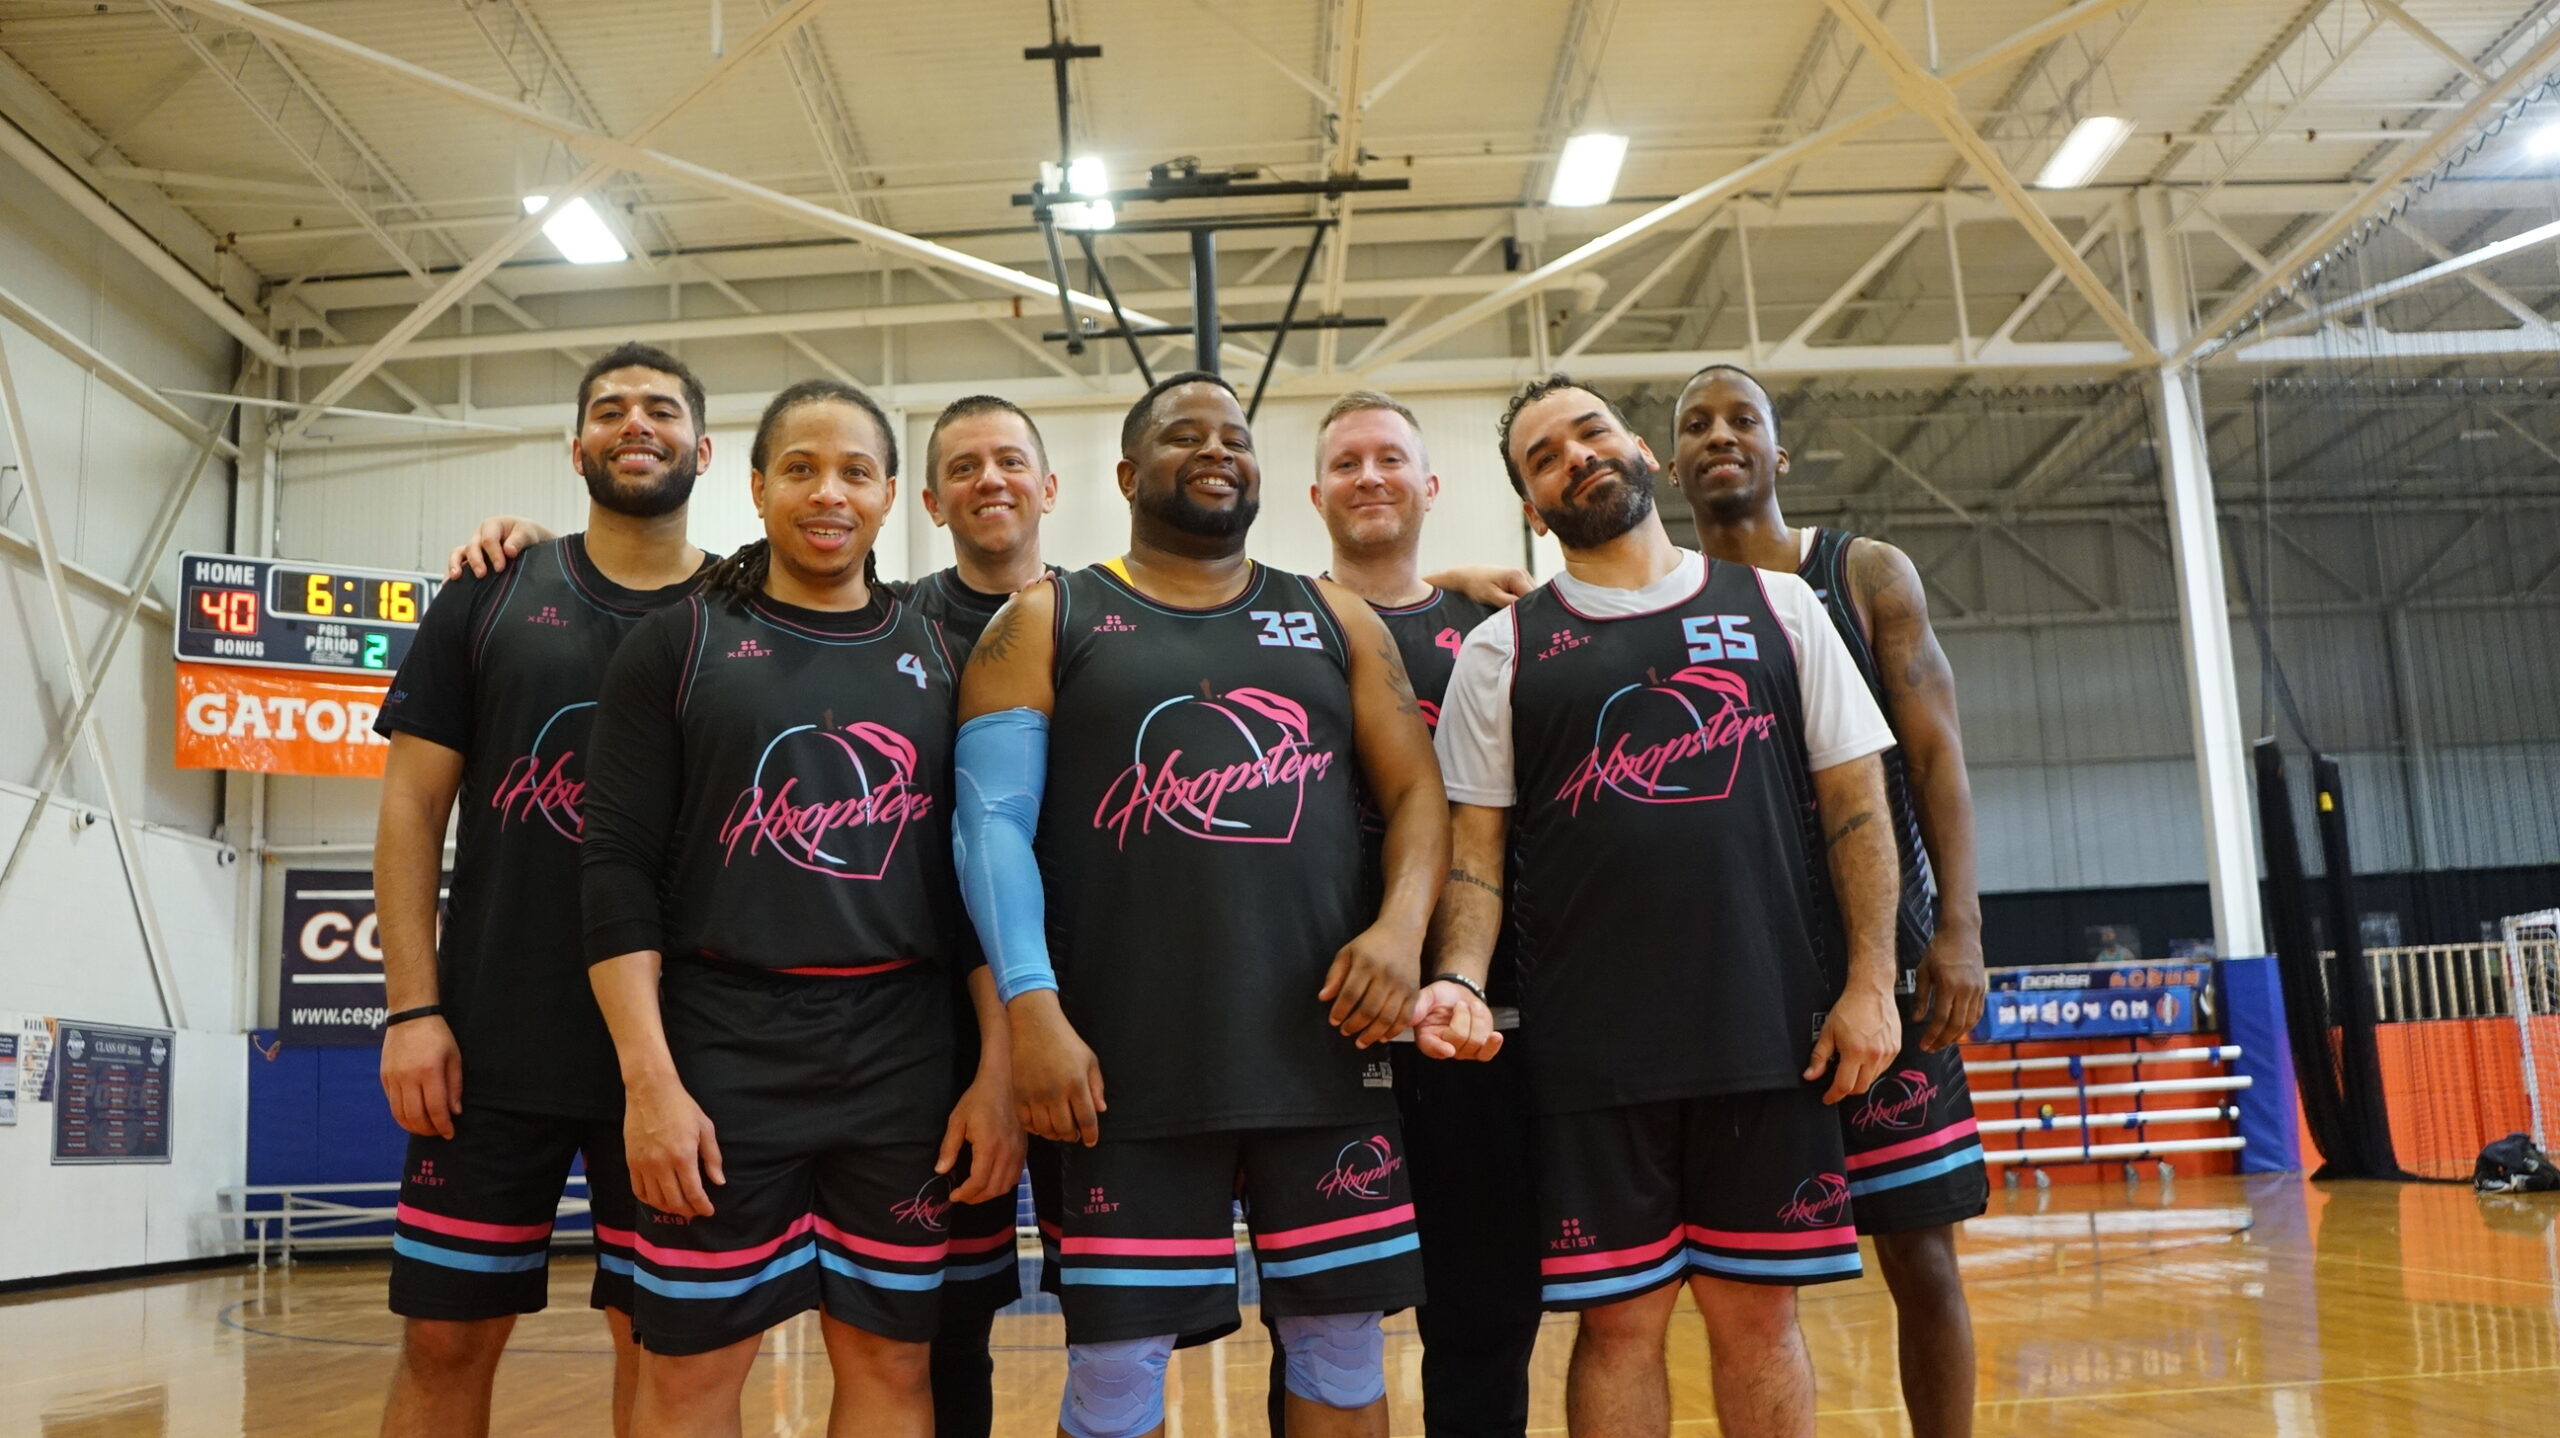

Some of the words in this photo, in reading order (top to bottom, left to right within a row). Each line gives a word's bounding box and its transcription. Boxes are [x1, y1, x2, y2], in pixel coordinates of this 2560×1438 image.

[195, 562, 256, 585] HOME
[202, 591, 256, 633] 40
[307, 573, 415, 623] 6:16
[318, 623, 347, 637] POSS
[1092, 624, 1137, 633] XEIST
[1250, 610, 1323, 650] 32
[1682, 614, 1759, 664] 55
[214, 638, 265, 658] BONUS
[305, 635, 359, 655] PERIOD
[364, 633, 388, 669] 2
[727, 648, 773, 658] XEIST
[1537, 635, 1591, 661] XEIST
[896, 652, 928, 690] 4
[1555, 700, 1777, 818] Hoopsters
[1093, 733, 1335, 853] Hoopsters
[719, 770, 935, 868] Hoopsters
[291, 1006, 388, 1030] www.cesp
[1550, 1235, 1597, 1249] XEIST
